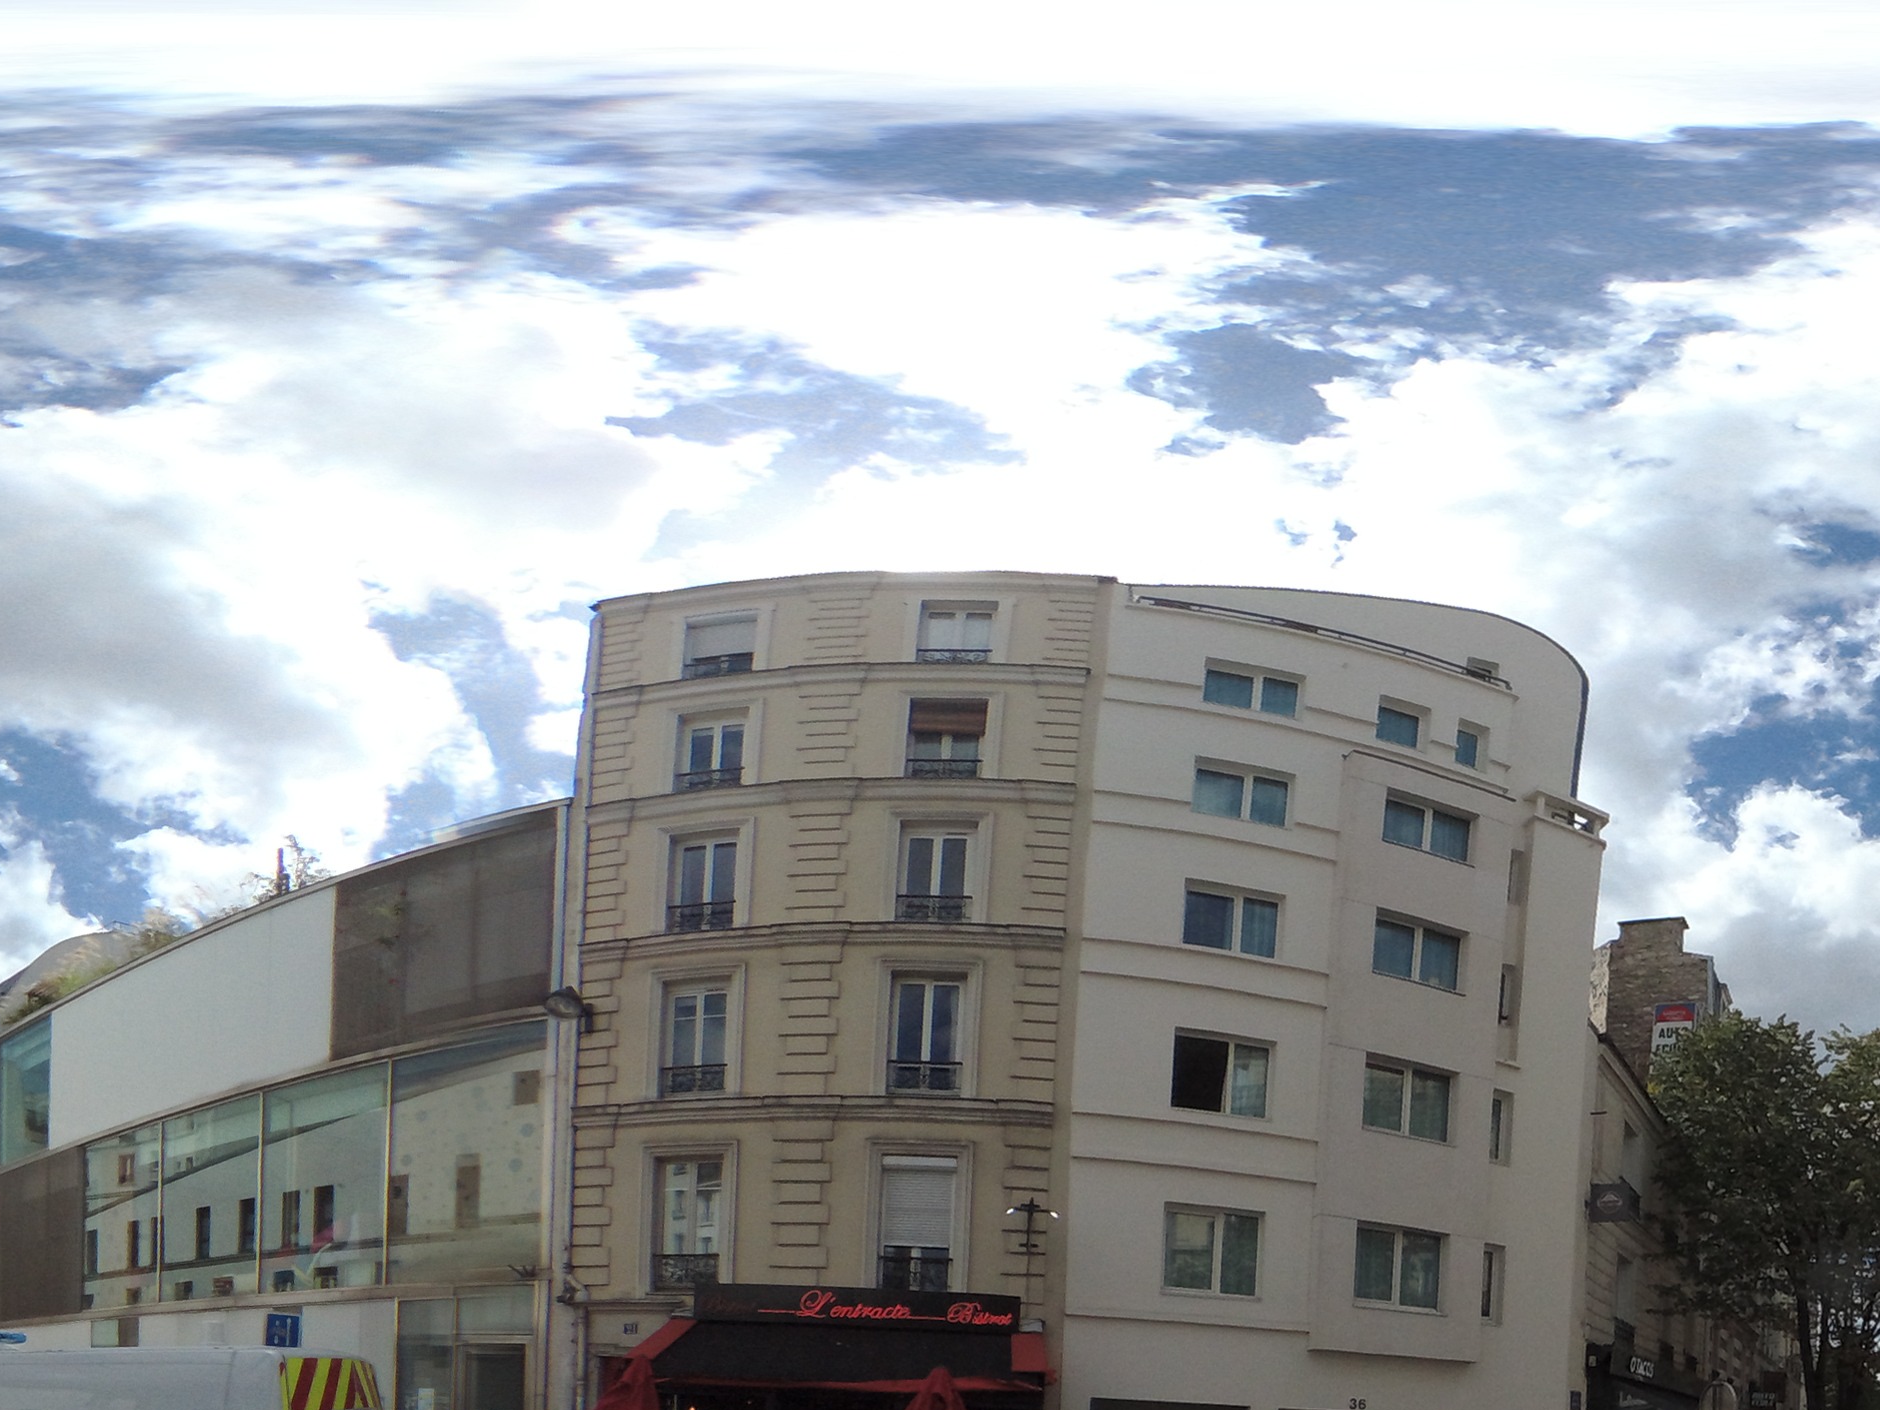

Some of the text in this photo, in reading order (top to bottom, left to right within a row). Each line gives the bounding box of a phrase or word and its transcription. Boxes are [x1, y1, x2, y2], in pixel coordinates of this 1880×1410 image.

[796, 1290, 911, 1318] L'entracte
[946, 1301, 1013, 1325] Bistrot
[1349, 1398, 1367, 1410] 36
